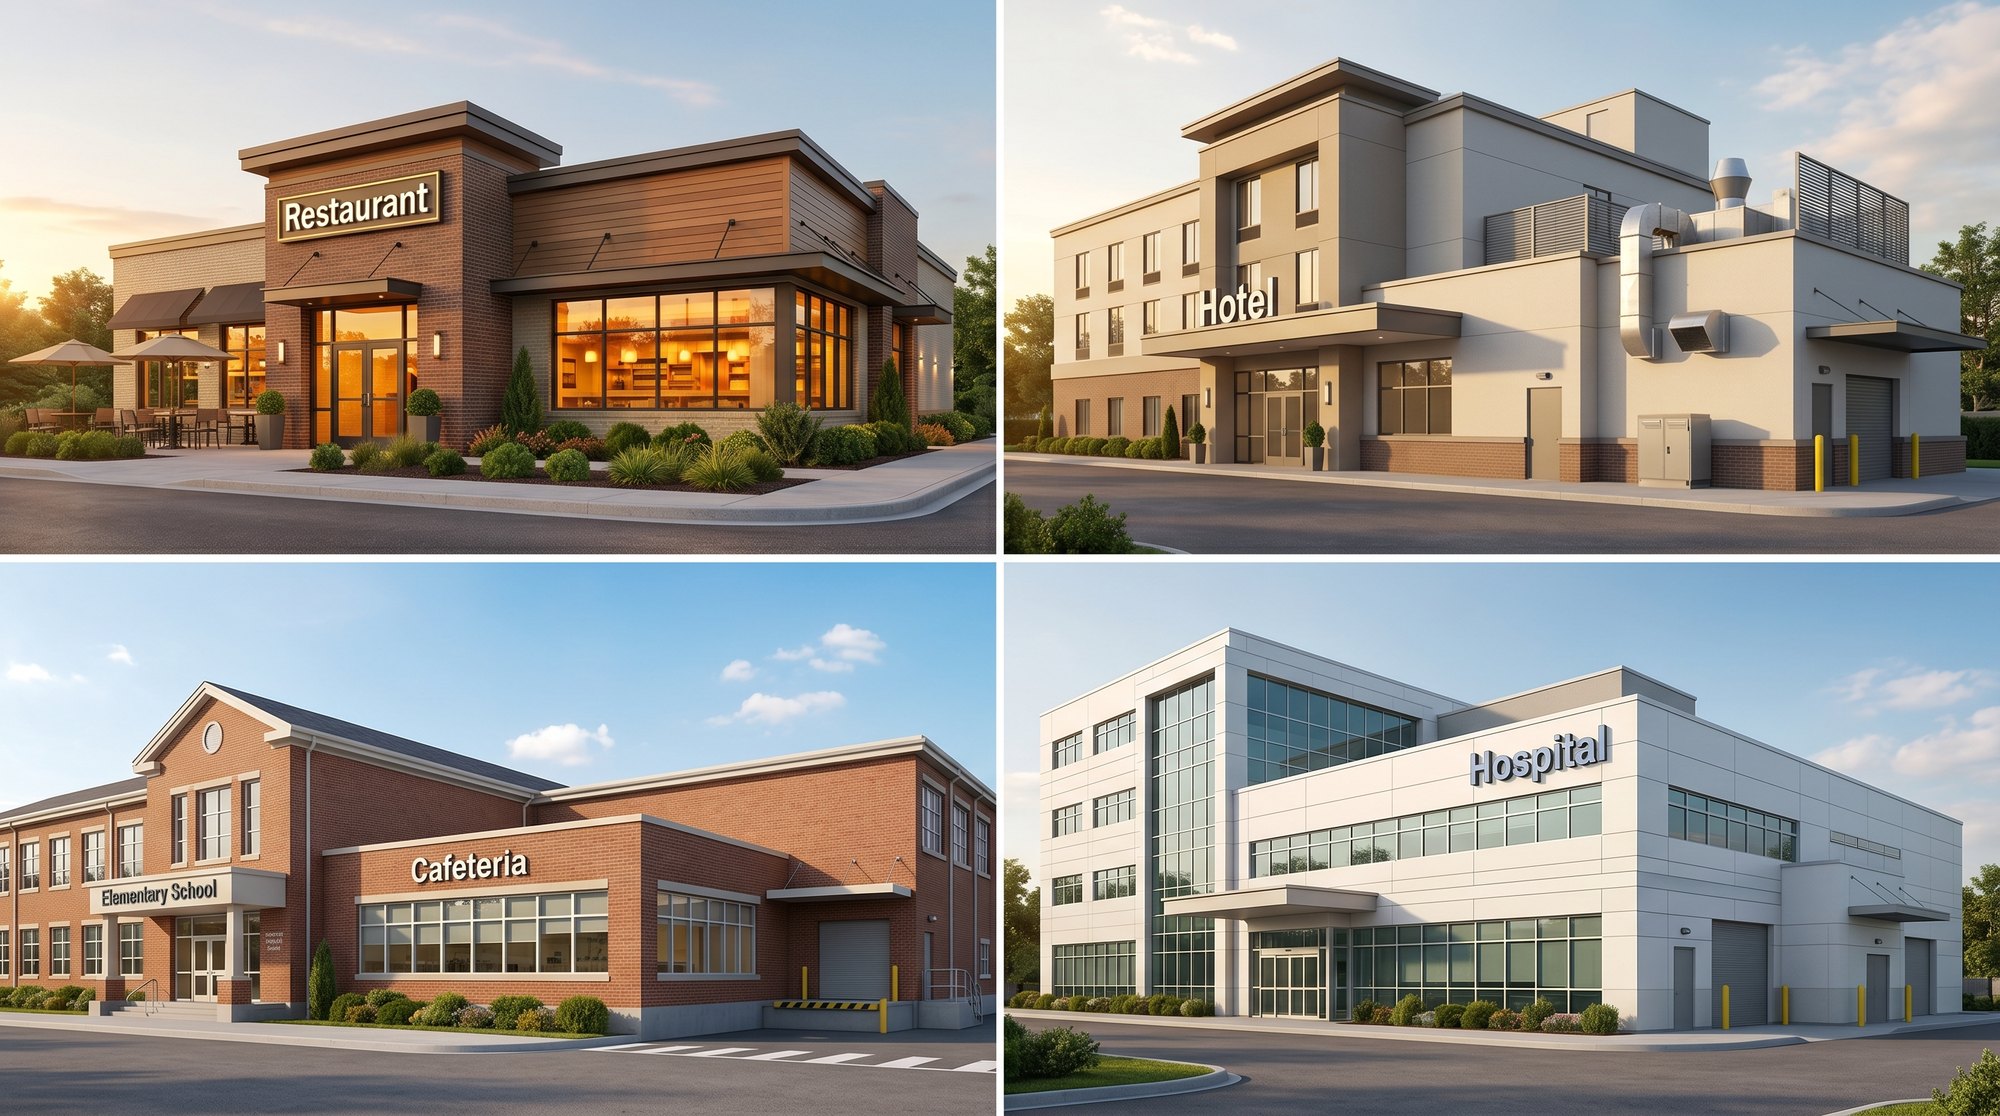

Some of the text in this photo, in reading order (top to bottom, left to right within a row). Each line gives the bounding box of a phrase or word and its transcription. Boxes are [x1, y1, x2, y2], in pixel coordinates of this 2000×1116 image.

[285, 182, 430, 232] Restaurant
[1199, 276, 1277, 327] Hotel
[1470, 724, 1608, 787] Hospital
[411, 849, 530, 884] Cafeteria
[101, 879, 218, 907] Elementary School
